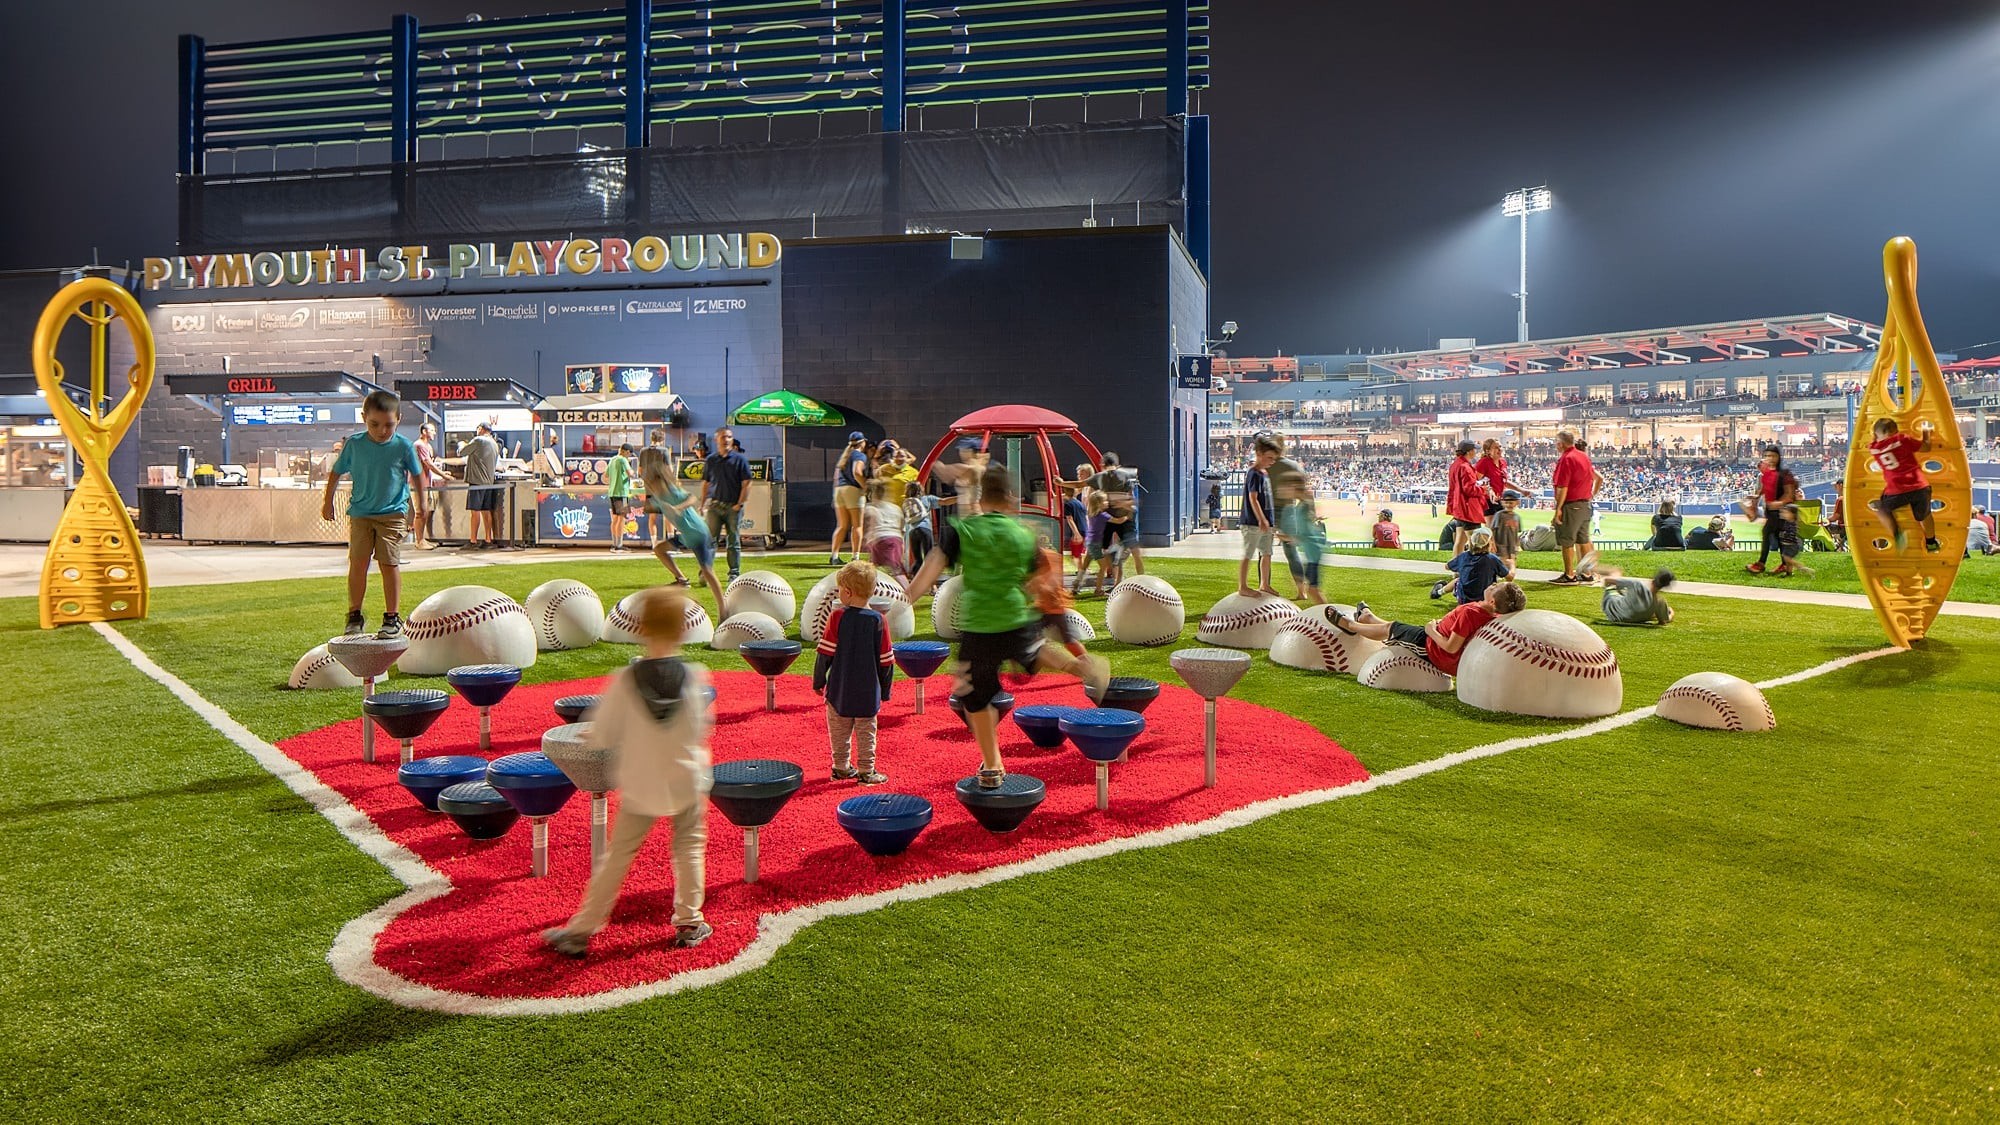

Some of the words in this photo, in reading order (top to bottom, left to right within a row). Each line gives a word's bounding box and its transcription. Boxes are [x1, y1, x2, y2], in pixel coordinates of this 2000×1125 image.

[143, 248, 366, 290] PLYMOUTH
[378, 246, 435, 282] ST.
[449, 232, 782, 279] PLAYGROUND
[488, 304, 537, 316] Homefield
[561, 305, 616, 313] WORKERS
[709, 299, 746, 310] METRO
[425, 307, 476, 321] Worcester
[172, 315, 205, 332] DCU
[228, 379, 276, 392] GRILL
[428, 385, 477, 399] BEER
[557, 411, 583, 422] ICE
[587, 411, 644, 422] CREAM
[1879, 452, 1900, 470] 9
[1383, 529, 1393, 541] 2
